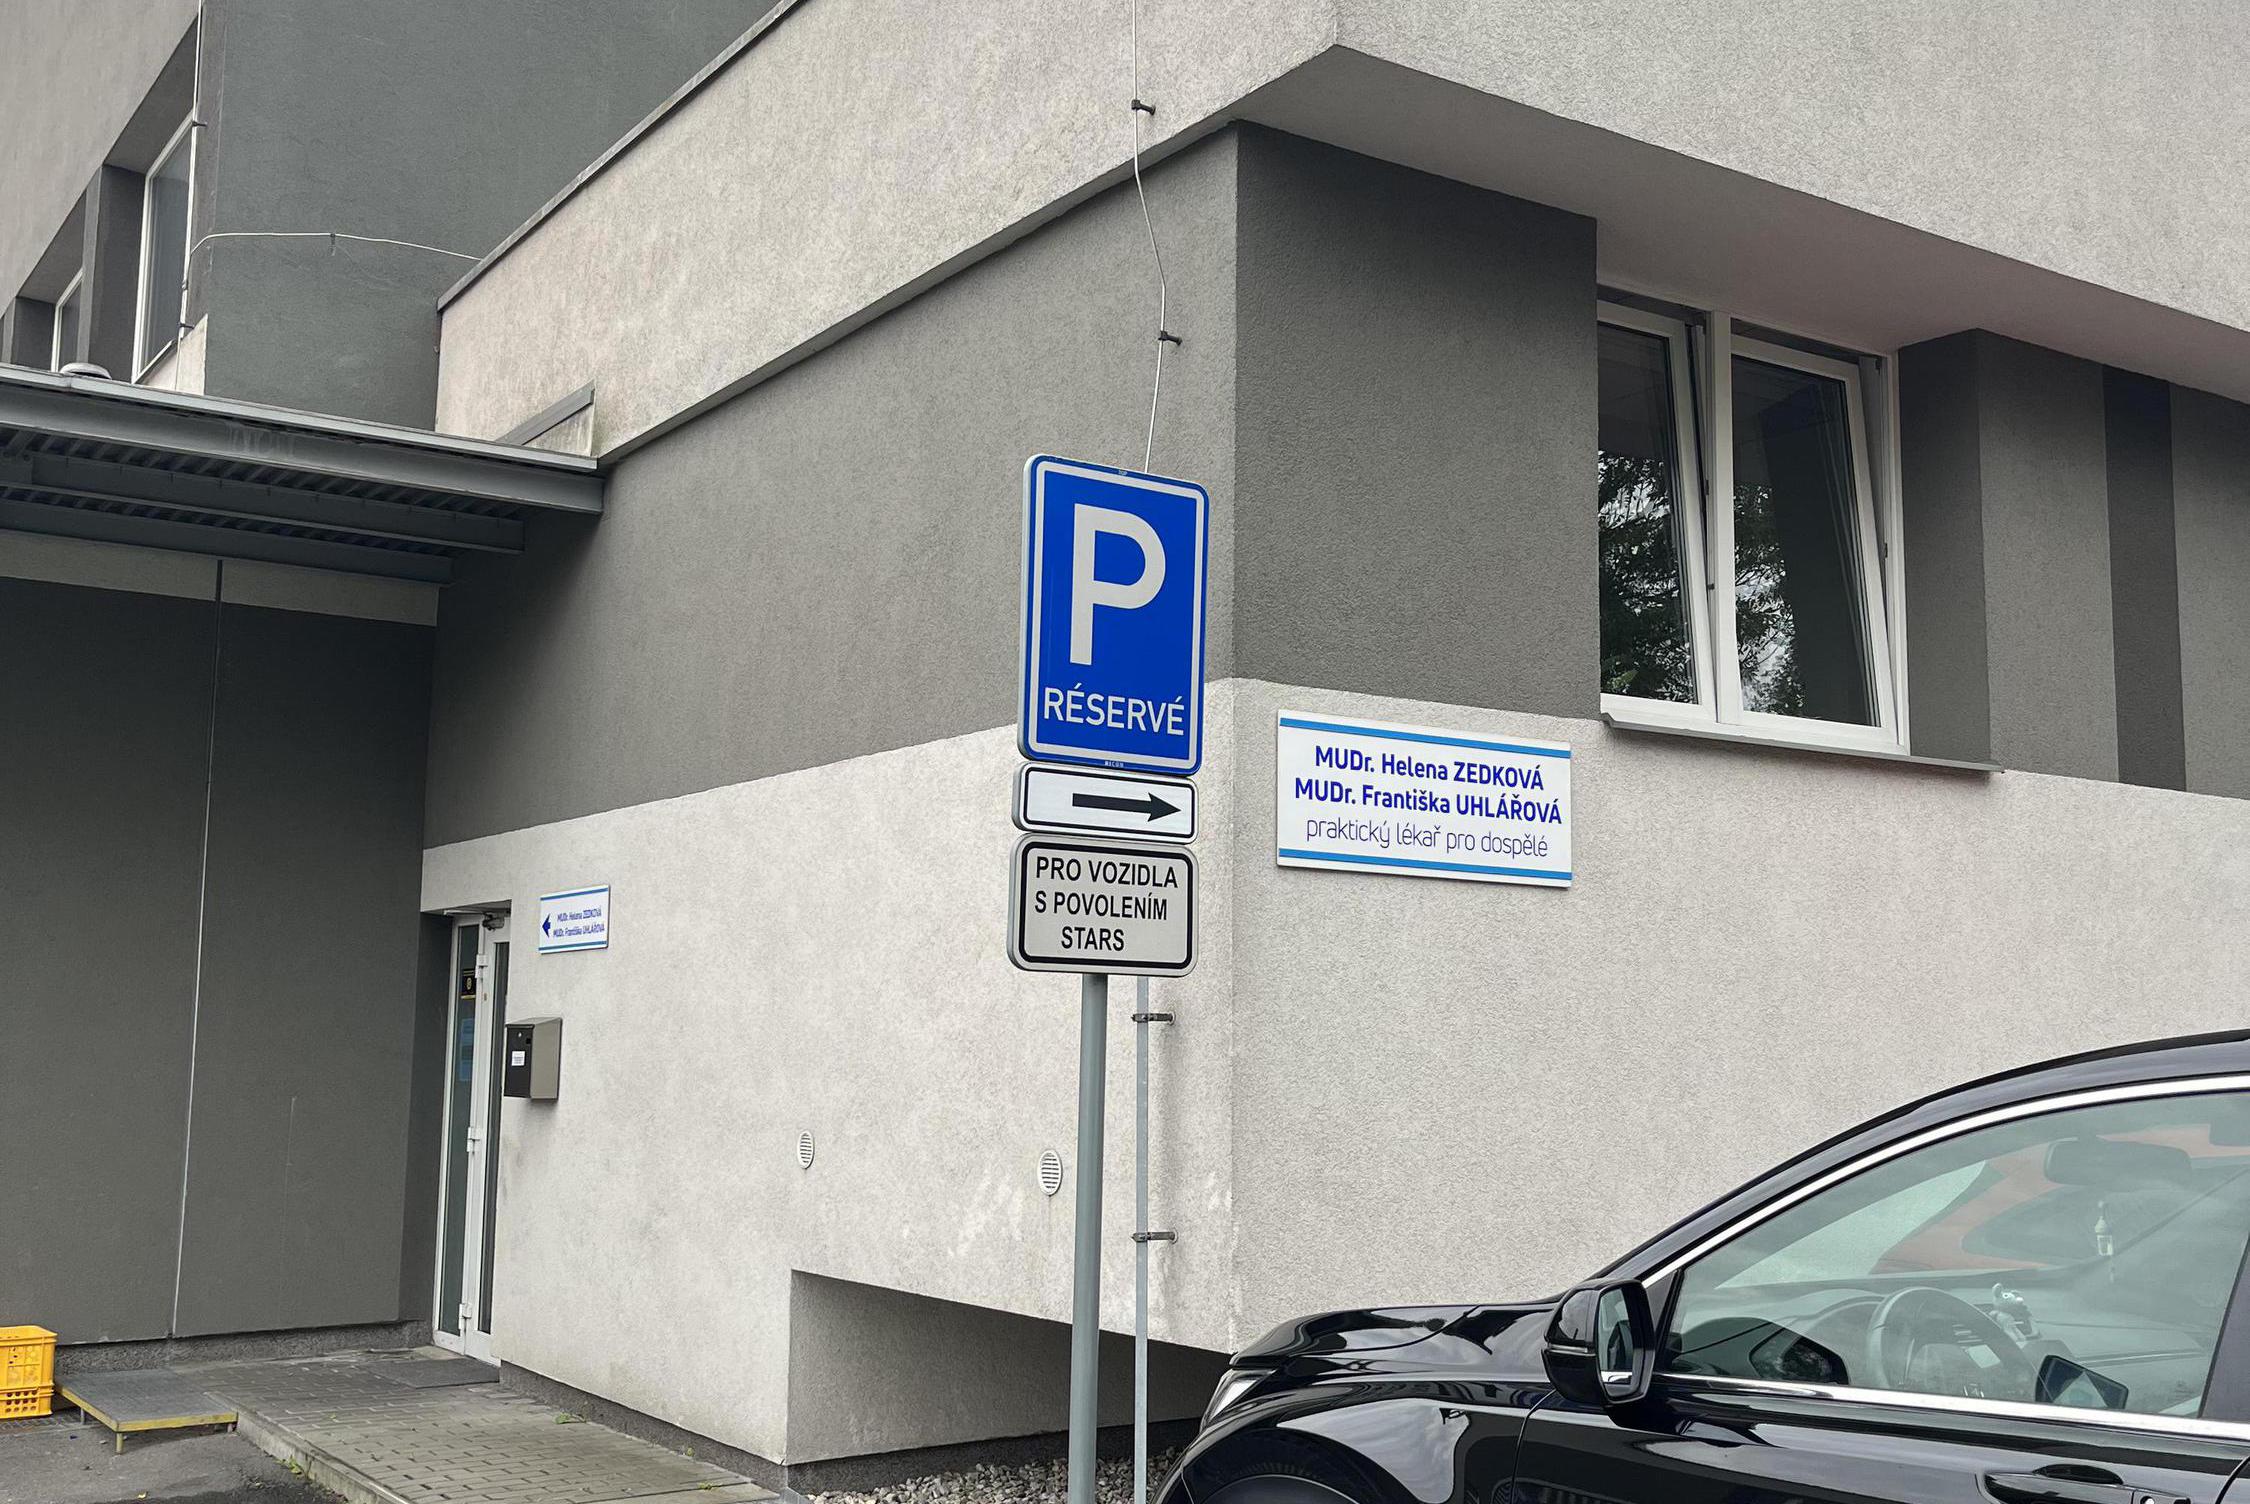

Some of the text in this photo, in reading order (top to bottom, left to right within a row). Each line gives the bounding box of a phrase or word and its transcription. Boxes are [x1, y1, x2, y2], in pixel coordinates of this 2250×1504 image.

[1069, 503, 1166, 666] P
[1043, 682, 1185, 736] RÉSERVÉ
[1315, 745, 1544, 791] MUDr. Helena ZEDKOVÁ
[1295, 777, 1562, 824] MUDr. Františka UHLÁŘOVÁ
[1306, 817, 1548, 859] praktický lékař pro dospělé
[1036, 856, 1178, 889] PRO VOZIDLA
[1034, 890, 1168, 921] S POVOLENÍM
[1061, 926, 1125, 952] STARS
